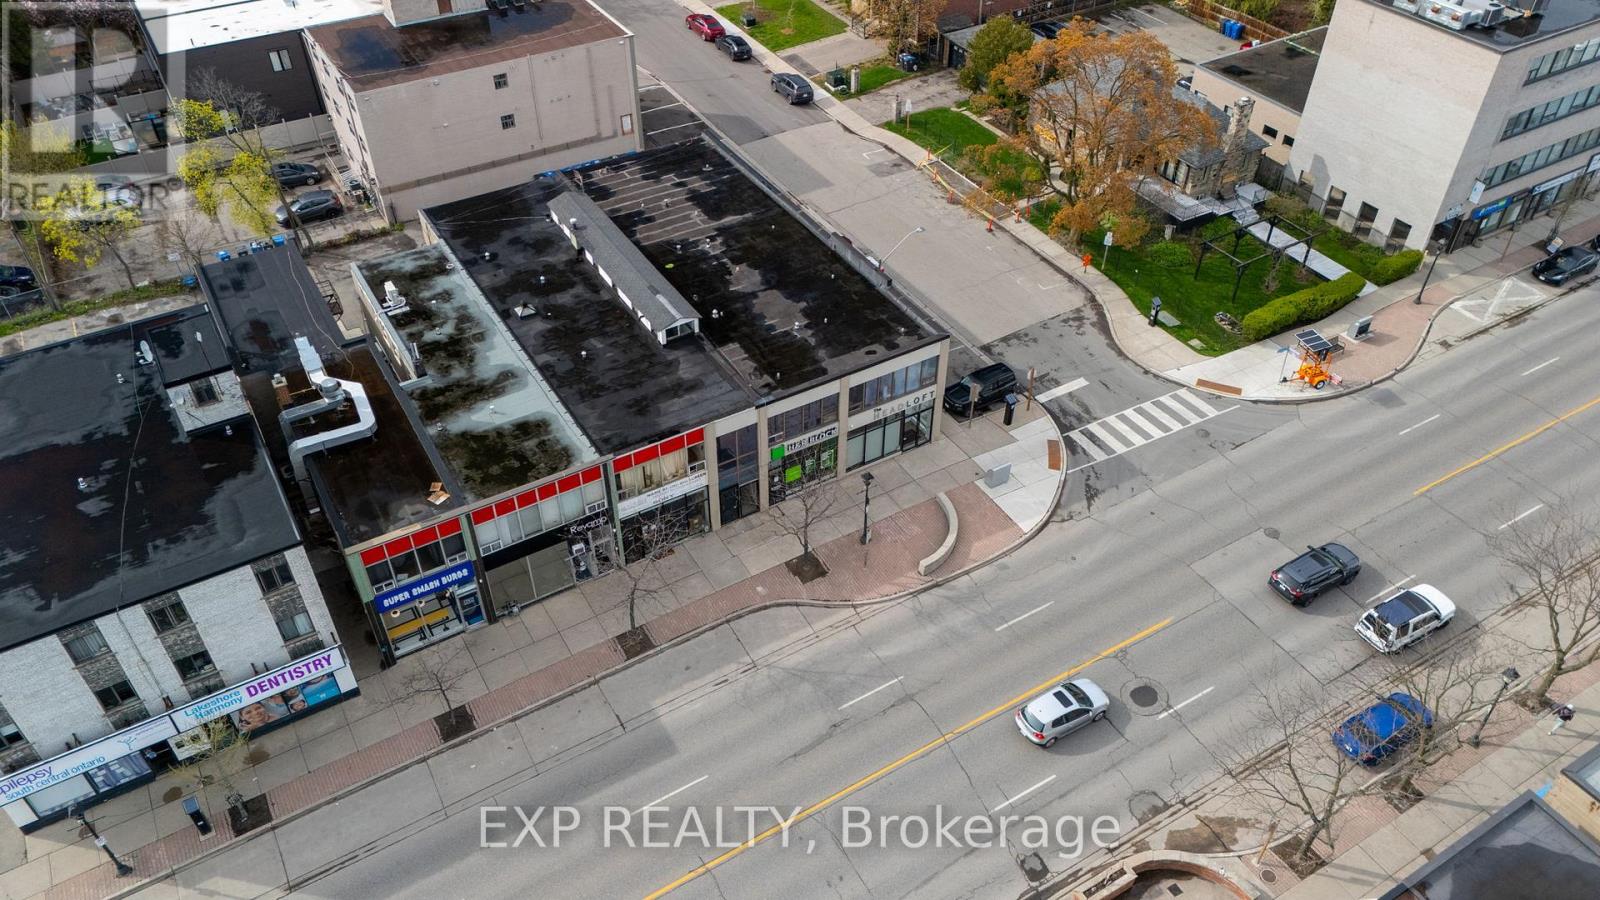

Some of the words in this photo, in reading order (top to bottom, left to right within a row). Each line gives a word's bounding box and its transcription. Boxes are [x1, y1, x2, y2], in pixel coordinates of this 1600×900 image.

[383, 590, 411, 608] SUPER
[411, 578, 441, 596] SMASH
[184, 689, 241, 717] Lakeshore
[245, 653, 332, 698] DENTISTRY
[193, 694, 244, 721] Harmony
[0, 765, 53, 795] pilepsy
[5, 784, 34, 801] south
[36, 768, 71, 789] central
[71, 755, 106, 774] ontario
